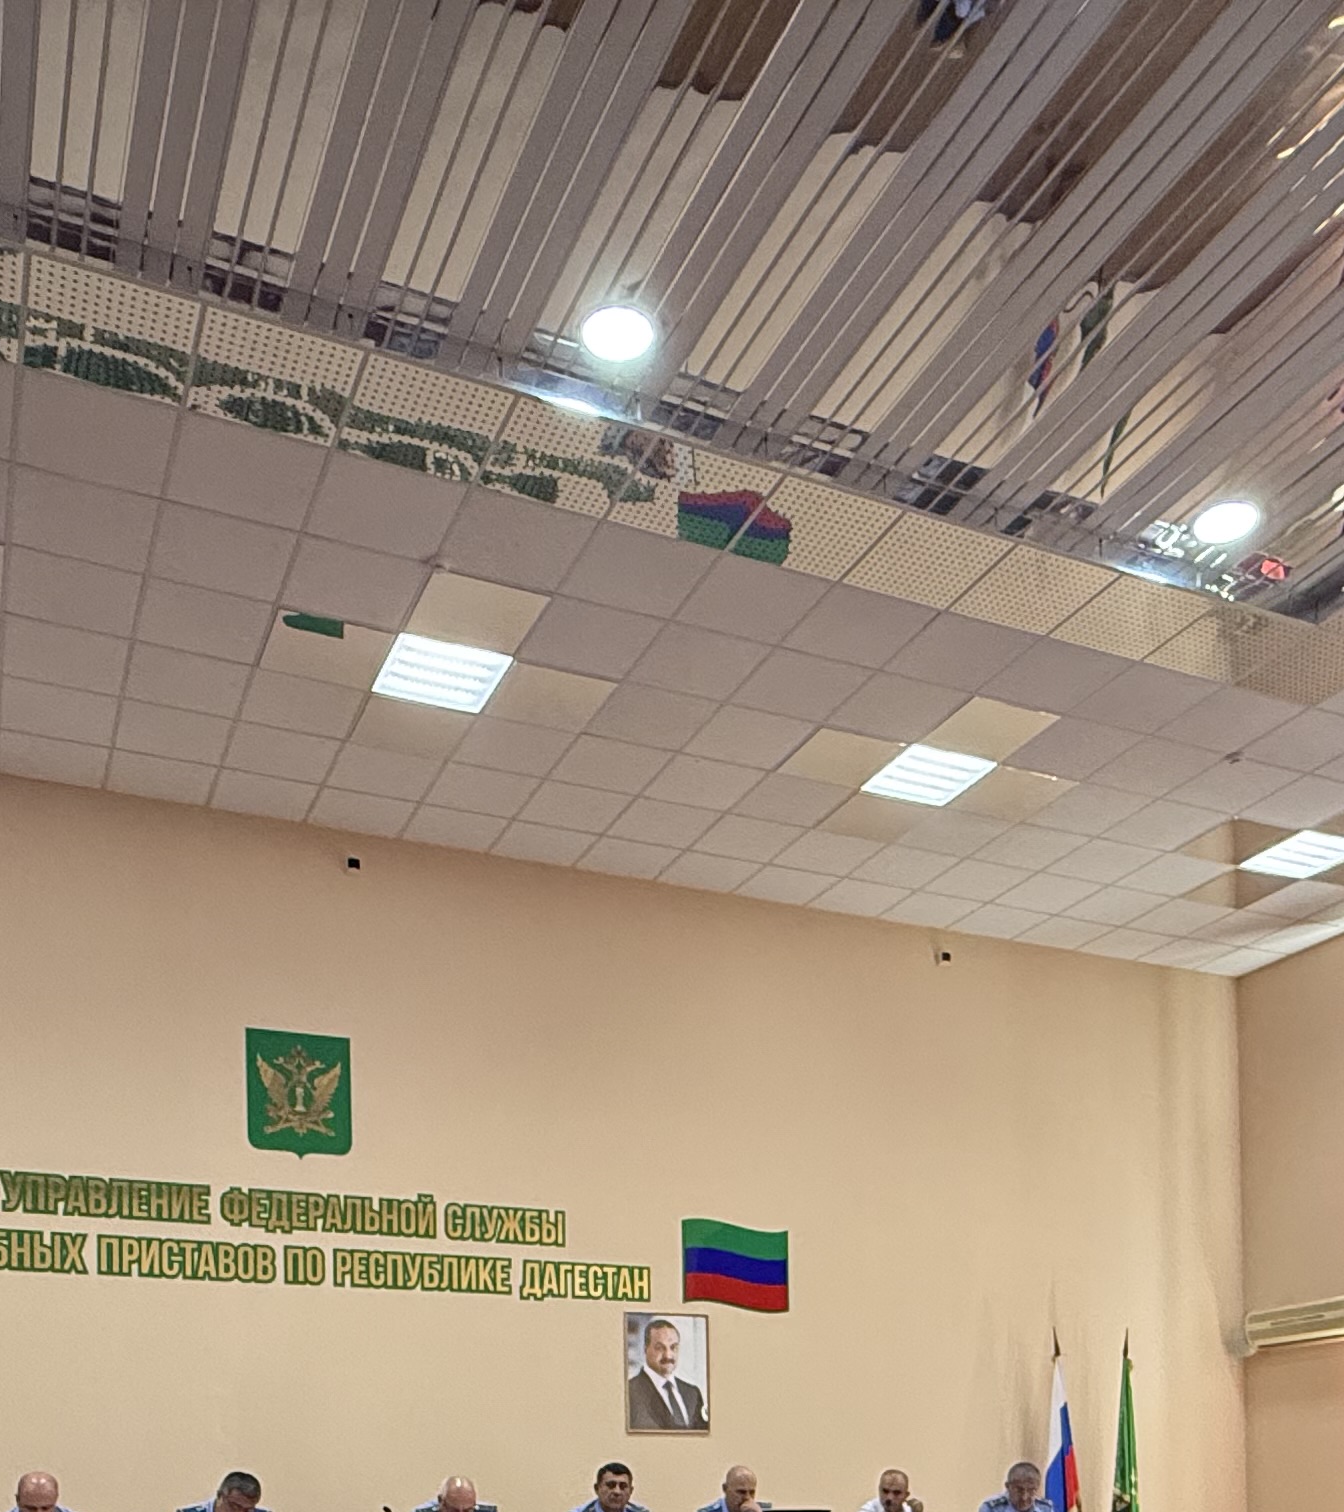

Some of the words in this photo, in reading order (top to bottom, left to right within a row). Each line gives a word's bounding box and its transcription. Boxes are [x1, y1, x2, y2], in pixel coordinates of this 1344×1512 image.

[220, 1186, 437, 1239] ФЕДЕРАЛЬНОЙ
[444, 1202, 567, 1248] СЛУЖБЫ
[97, 1233, 277, 1285] ПРИСТАВОВ
[284, 1245, 326, 1287] ПО
[333, 1248, 513, 1295] РЕСПУБЛИКЕ
[519, 1259, 651, 1303] ДАГЕСТАН
